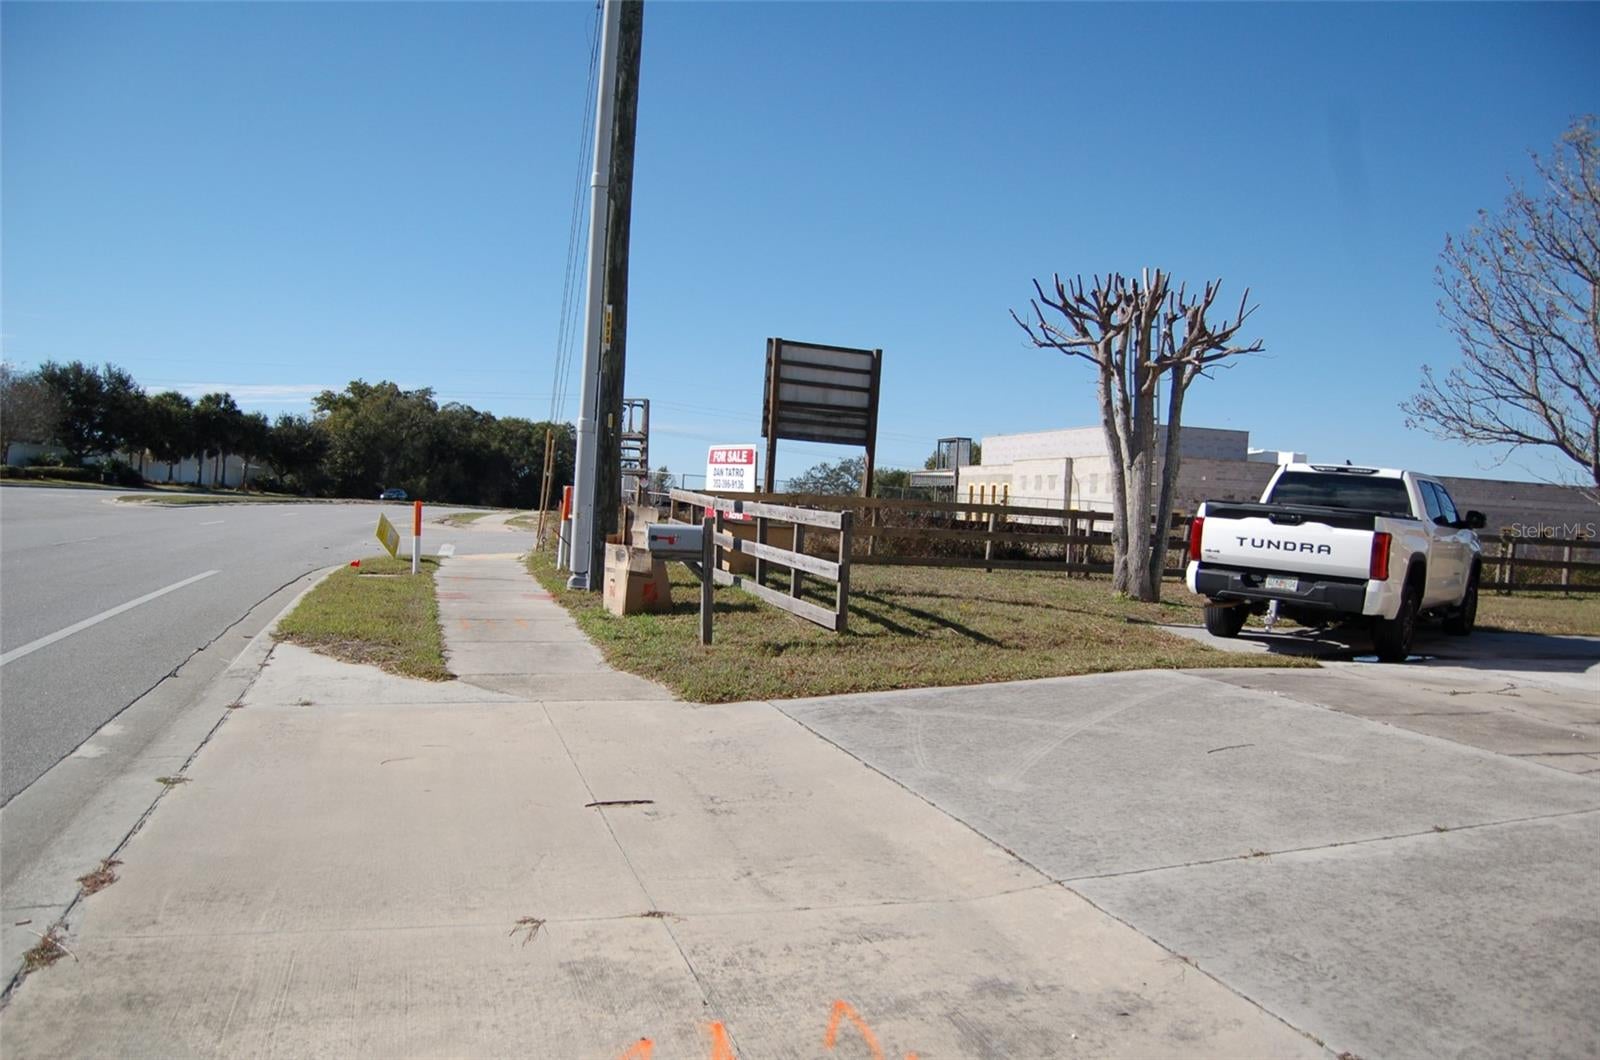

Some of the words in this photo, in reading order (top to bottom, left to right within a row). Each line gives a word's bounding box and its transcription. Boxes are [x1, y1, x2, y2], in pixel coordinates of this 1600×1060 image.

[713, 450, 727, 463] FOR
[727, 450, 748, 463] SALE
[713, 467, 724, 477] DAN
[725, 467, 744, 477] TATRO
[1236, 536, 1332, 555] TUNDRA
